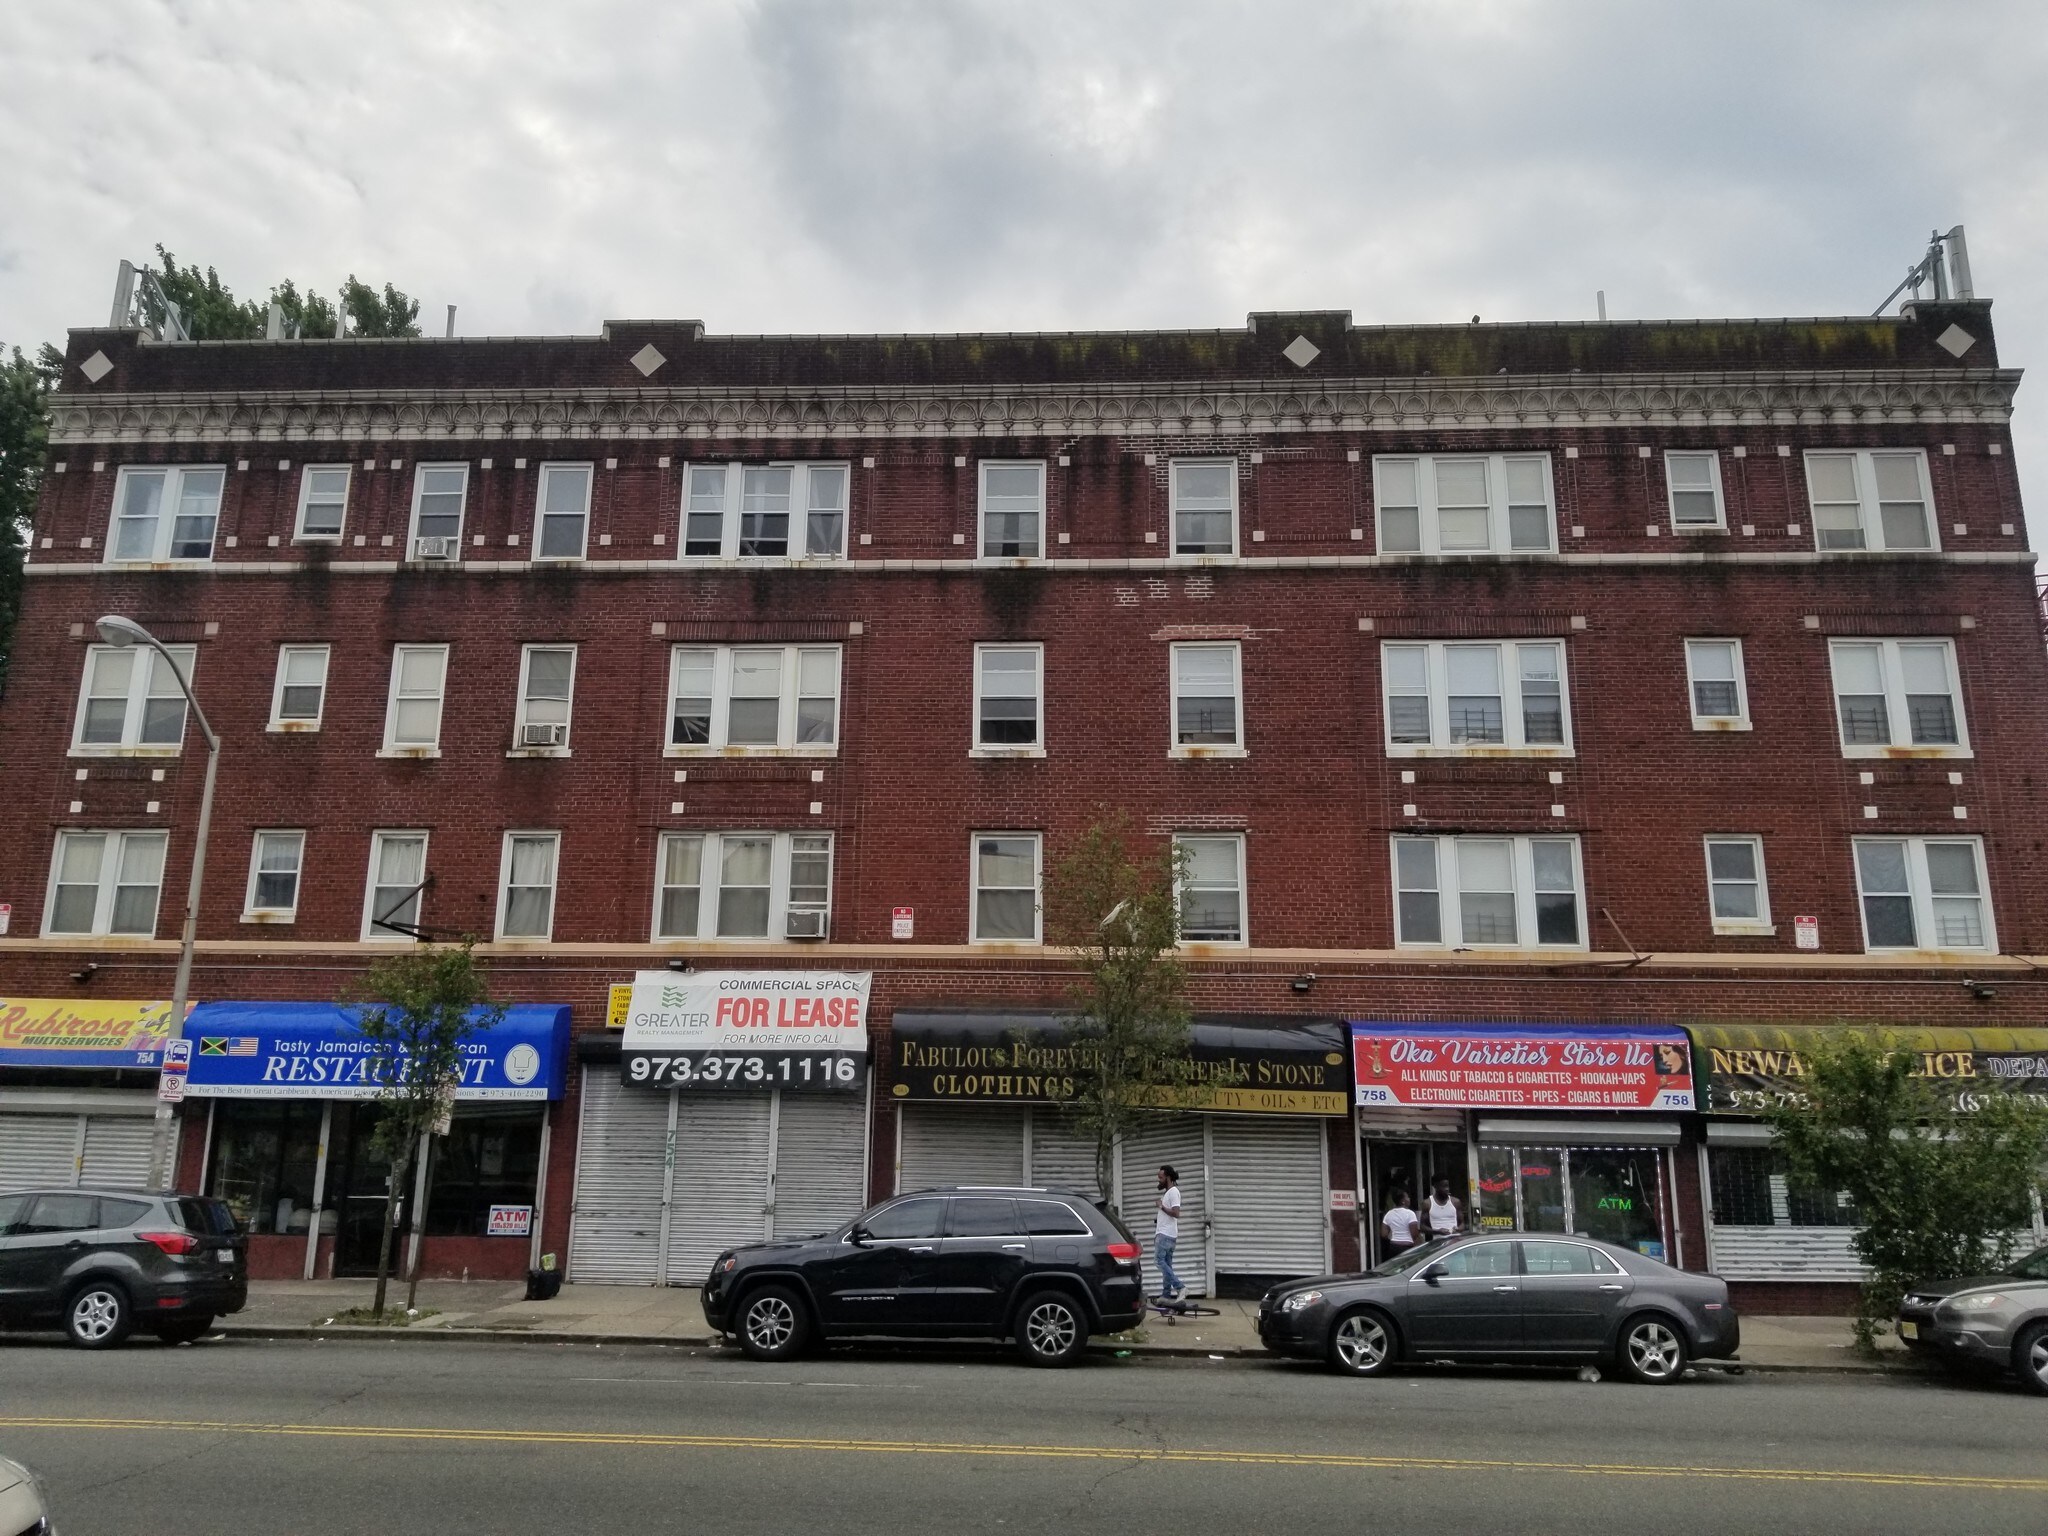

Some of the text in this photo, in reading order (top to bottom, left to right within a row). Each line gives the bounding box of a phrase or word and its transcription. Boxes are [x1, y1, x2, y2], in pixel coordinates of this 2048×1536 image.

[719, 980, 860, 992] COMMERCIAL SPACE
[715, 997, 860, 1028] FOR LEASE
[0, 1006, 135, 1039] Rubirosa
[634, 1013, 709, 1027] GREATER
[21, 1036, 125, 1046] MULTISERVICES
[723, 1034, 839, 1044] FOR MORE INFO CALL
[274, 1040, 311, 1054] Tasty
[398, 1042, 409, 1054] &
[1390, 1040, 1437, 1063] Oka
[1441, 1041, 1551, 1066] Varieties
[1560, 1042, 1620, 1067] Store
[136, 1052, 155, 1064] 754
[902, 1041, 1006, 1068] FABULOUS
[630, 1057, 855, 1081] 973.373.1116
[1710, 1048, 1810, 1076] NEWA
[1257, 1058, 1325, 1085] STONE
[1401, 1069, 1417, 1082] ALL
[1420, 1070, 1448, 1082] KINDS
[1450, 1070, 1461, 1082] OF
[1463, 1071, 1505, 1083] TABACCO
[1508, 1072, 1514, 1083] &
[1516, 1072, 1571, 1084] CIGARETTES
[1580, 1073, 1645, 1085] HOOKAH-VAPS
[933, 1074, 1074, 1096] CLOTHINGS
[1261, 1093, 1296, 1109] OILS
[1313, 1096, 1341, 1110] ETC
[1362, 1090, 1387, 1100] 758
[1410, 1088, 1466, 1100] ELECTRONIC
[1469, 1089, 1523, 1102] CIGARETTES
[1533, 1091, 1559, 1102] PIPES
[1568, 1091, 1601, 1103] CIGARS
[1603, 1092, 1610, 1103] &
[1612, 1092, 1639, 1103] MORE
[1663, 1095, 1689, 1105] 758
[665, 1130, 676, 1169] 754
[1521, 1167, 1552, 1176] OPEN
[1598, 1198, 1633, 1211] ATM
[493, 1211, 528, 1222] ATM
[1481, 1217, 1513, 1226] SWEETS
